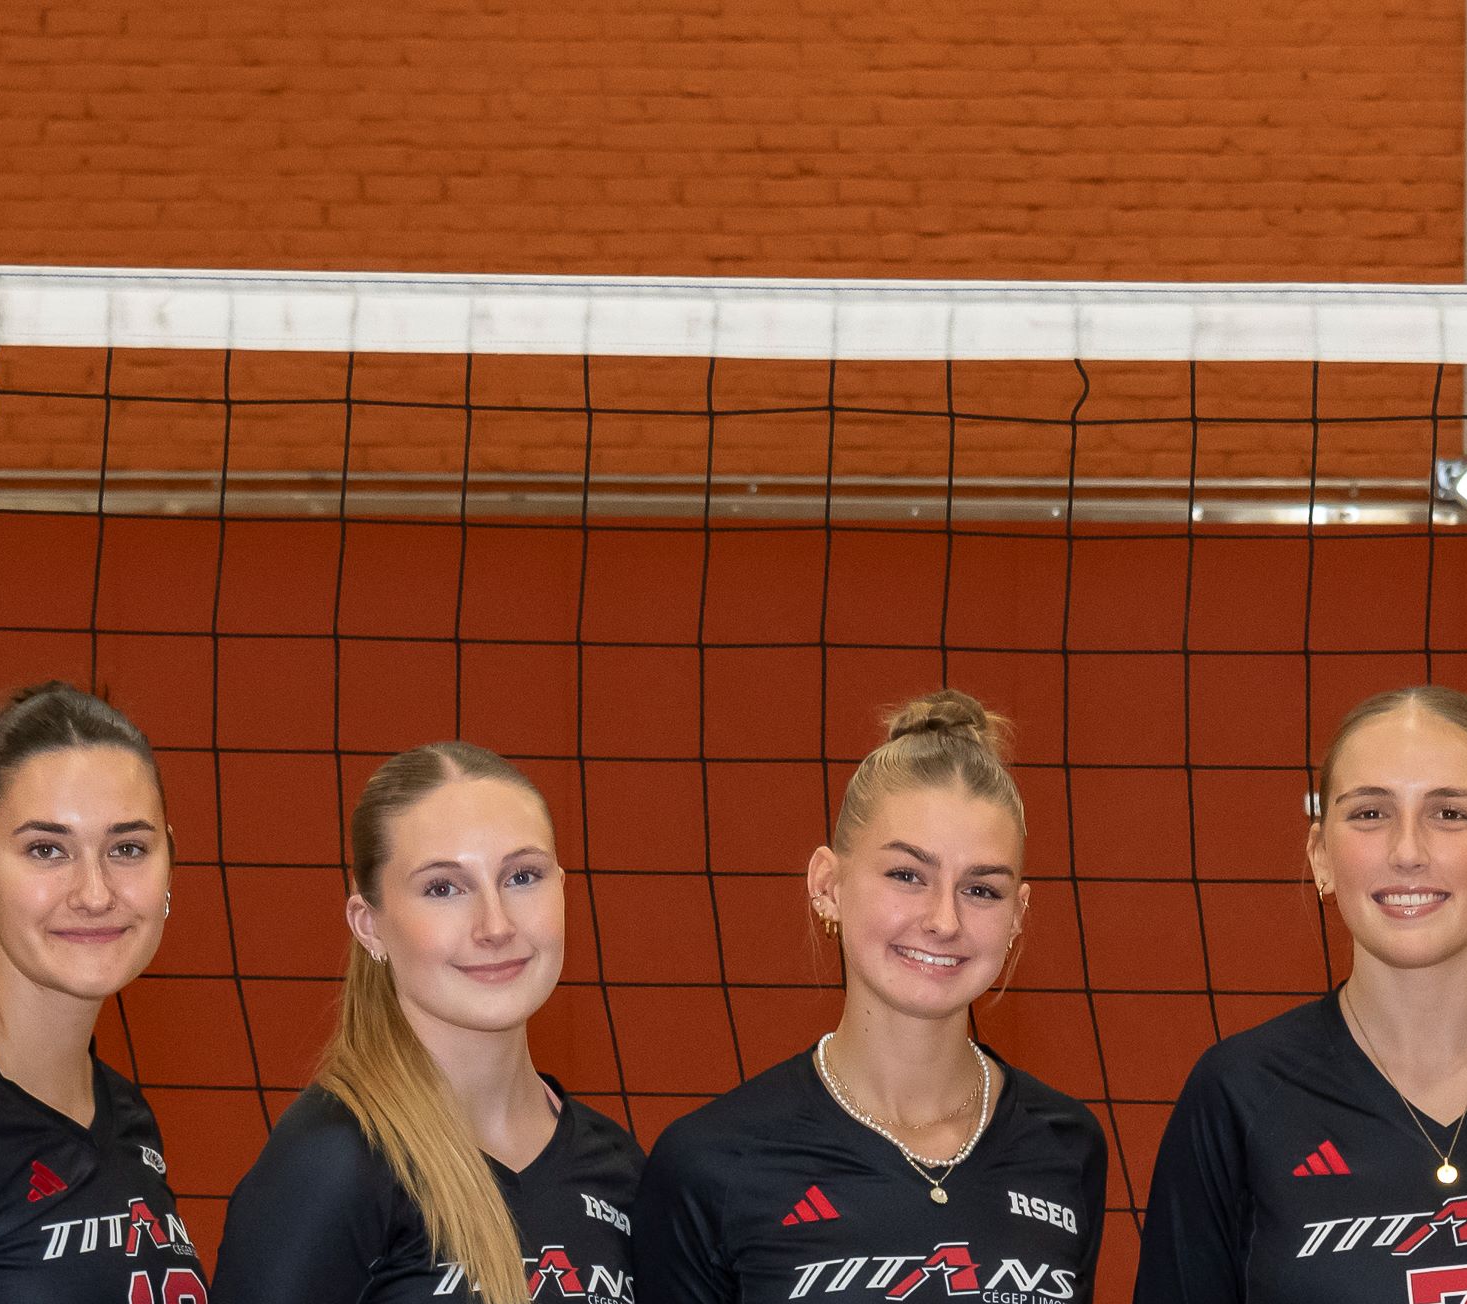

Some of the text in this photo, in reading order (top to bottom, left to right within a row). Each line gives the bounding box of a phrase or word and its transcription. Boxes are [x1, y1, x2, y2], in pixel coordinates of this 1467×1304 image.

[40, 1197, 191, 1261] TITAN
[1007, 1190, 1078, 1235] RSEQ
[787, 1241, 1077, 1301] TITANS
[982, 1289, 1029, 1304] CÉGEP
